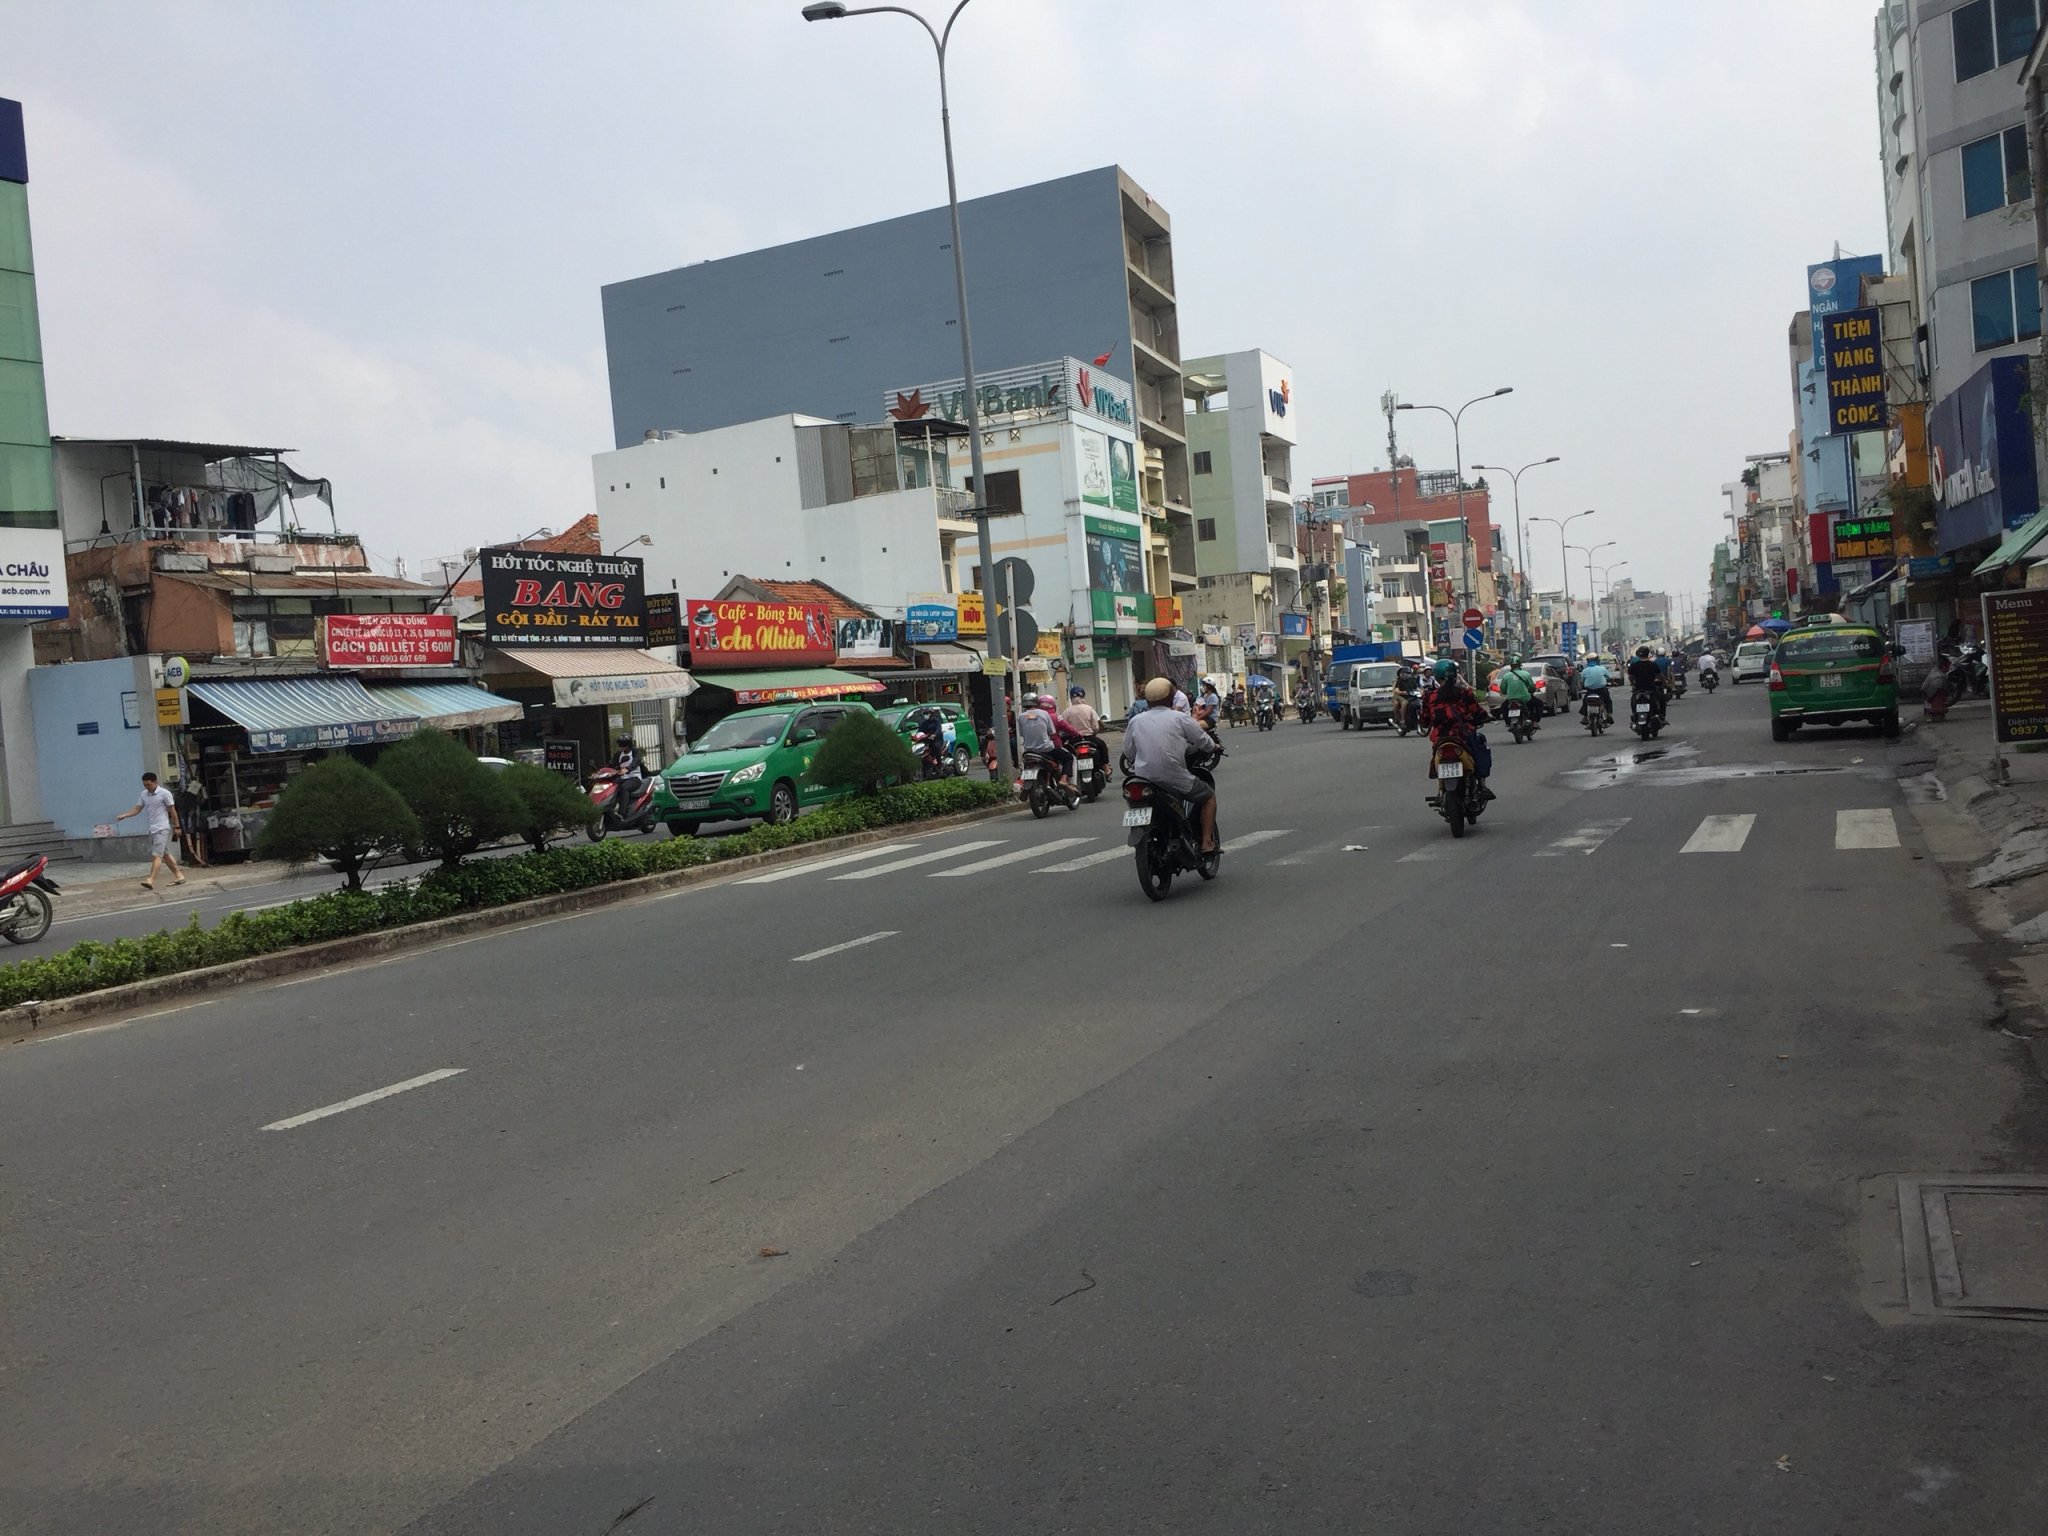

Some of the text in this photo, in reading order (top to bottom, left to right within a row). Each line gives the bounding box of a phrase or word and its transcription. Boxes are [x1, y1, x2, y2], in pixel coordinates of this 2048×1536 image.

[1812, 300, 1838, 313] NGÂN
[1833, 318, 1871, 341] TIỆM
[1834, 346, 1875, 368] VÀNG
[1832, 374, 1881, 397] THÀNH
[6, 561, 49, 577] CHÂU
[491, 552, 638, 578] HỚT TÓC NGHỆ THUẬT
[1, 586, 51, 596] acb.com.vn
[511, 579, 625, 609] BANG
[719, 604, 746, 623] Café
[757, 604, 785, 624] Bóng
[788, 605, 804, 621] Đá
[1995, 599, 2033, 610] Menu
[496, 610, 529, 629] GỘI
[534, 608, 568, 626] ĐẦU
[578, 610, 610, 627] RÁY
[614, 615, 640, 627] TAI
[333, 639, 452, 654] CÁCH ĐÀI LIỆT SĨ 60M
[720, 625, 807, 650] An Nhiên
[167, 667, 183, 678] ACB
[2010, 725, 2038, 735] 0937
